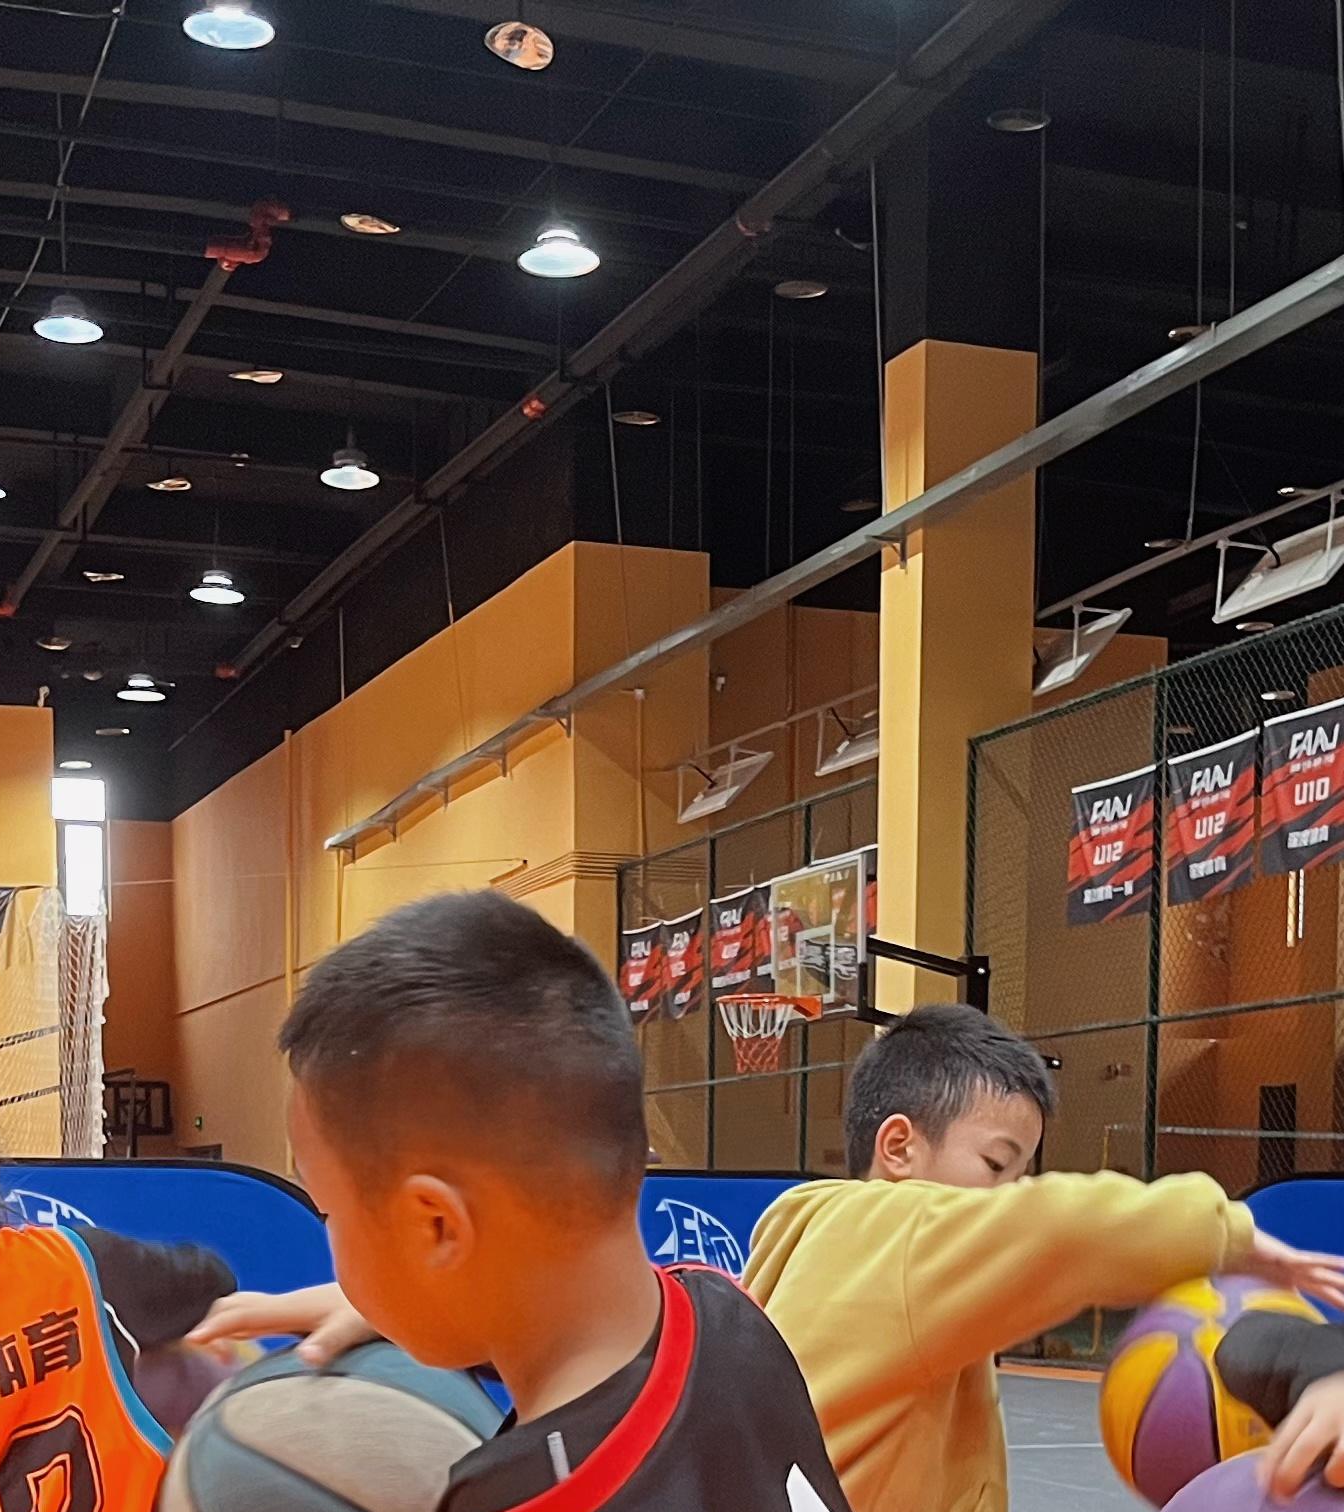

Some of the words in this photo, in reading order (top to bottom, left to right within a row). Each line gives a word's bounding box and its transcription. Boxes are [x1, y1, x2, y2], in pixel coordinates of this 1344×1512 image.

[1294, 776, 1330, 806] U10
[1194, 811, 1226, 840] U12
[1093, 840, 1125, 866] U12
